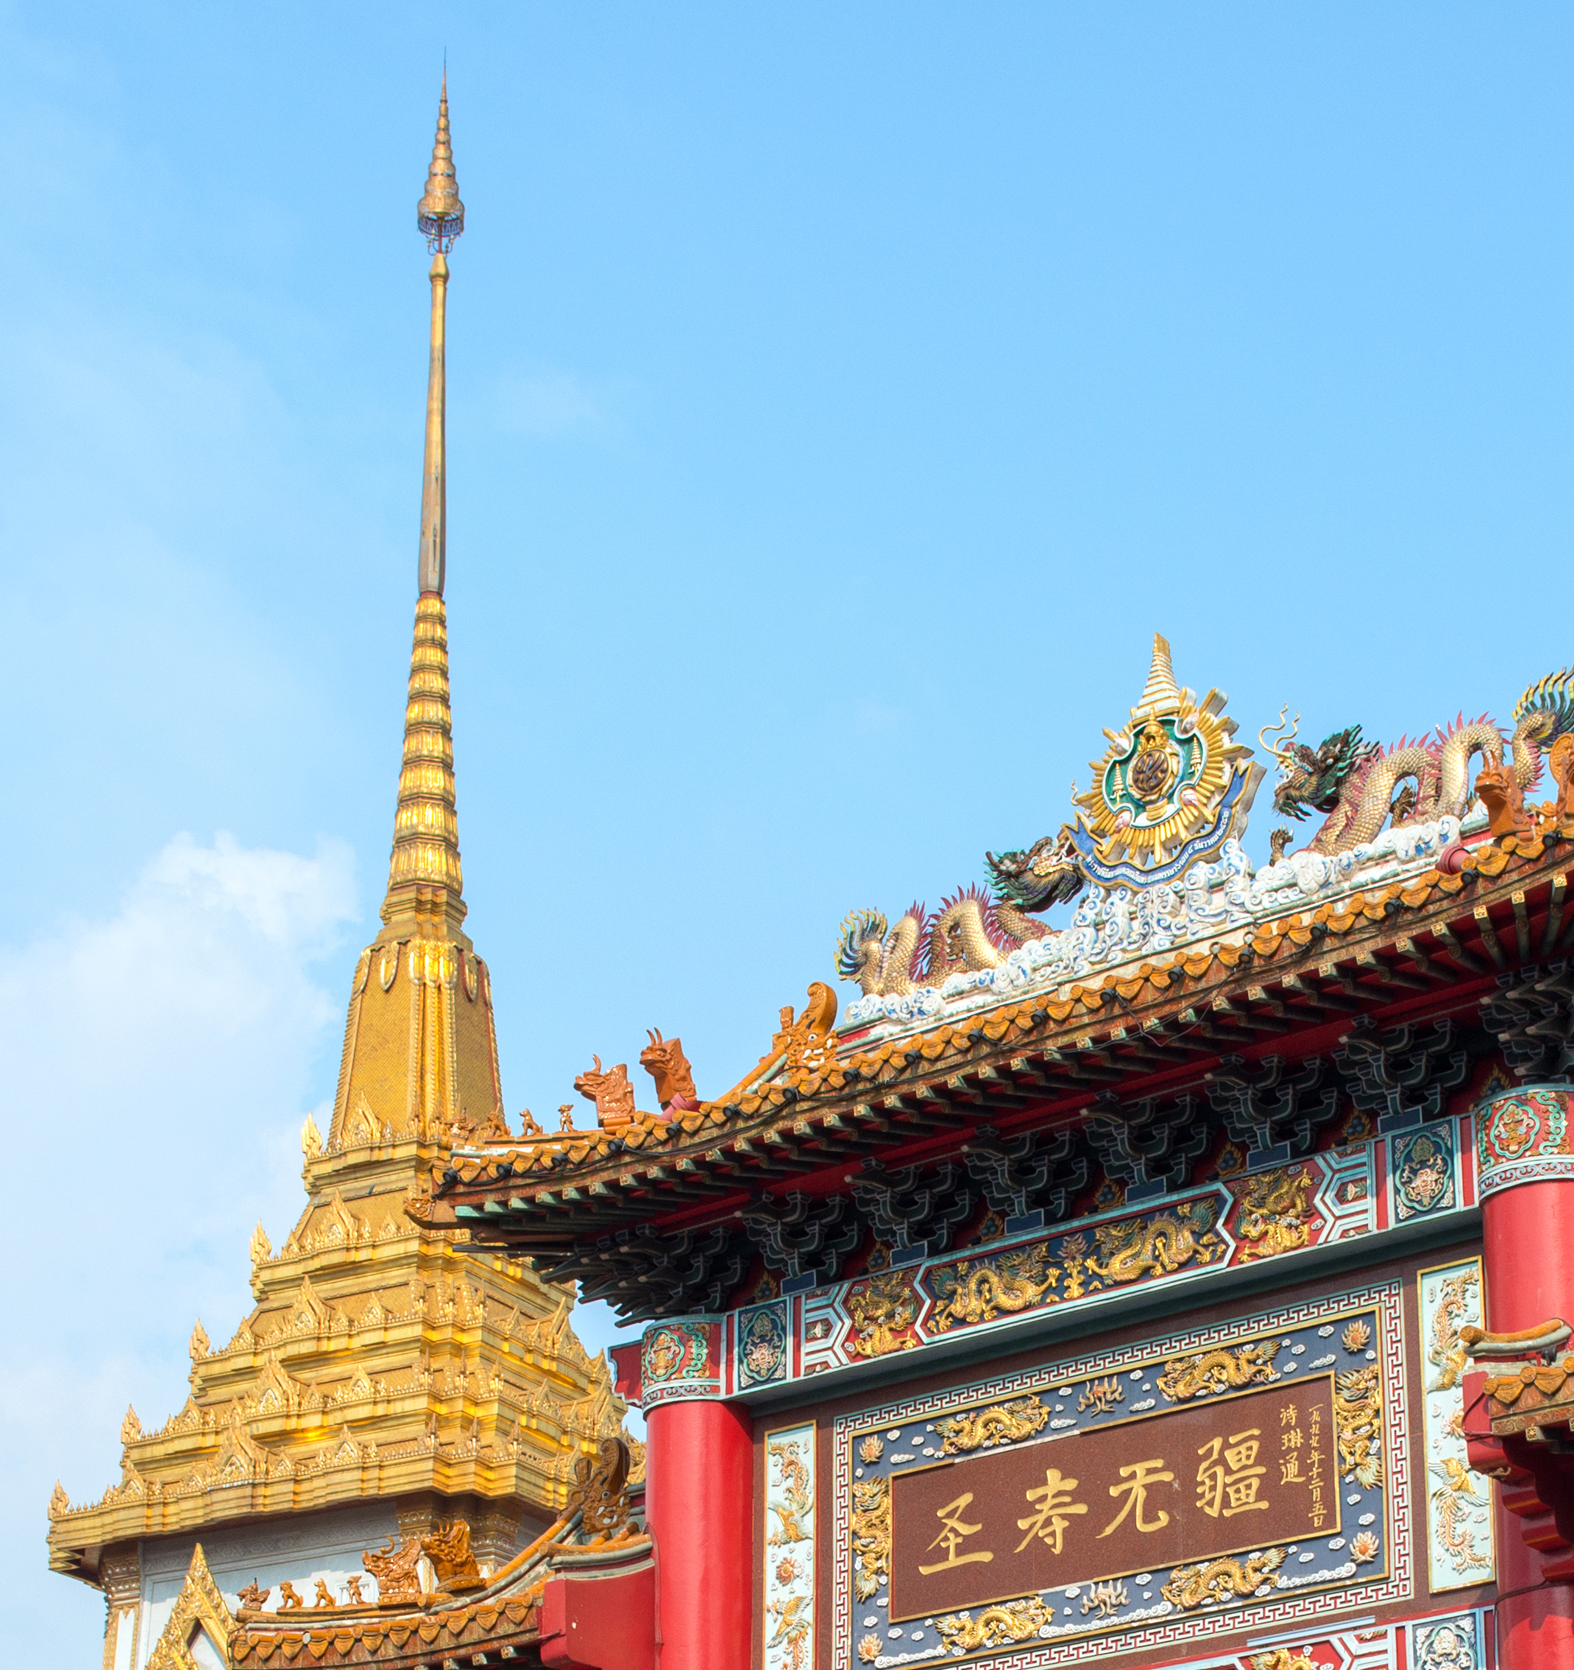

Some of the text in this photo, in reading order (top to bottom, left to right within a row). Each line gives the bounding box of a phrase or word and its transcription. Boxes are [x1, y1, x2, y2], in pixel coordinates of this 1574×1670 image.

[918, 1427, 1270, 1576] 圣寿无疆
[1279, 1404, 1306, 1486] 诗琳通
[1306, 1403, 1328, 1527] 一九九九年十二月五日
